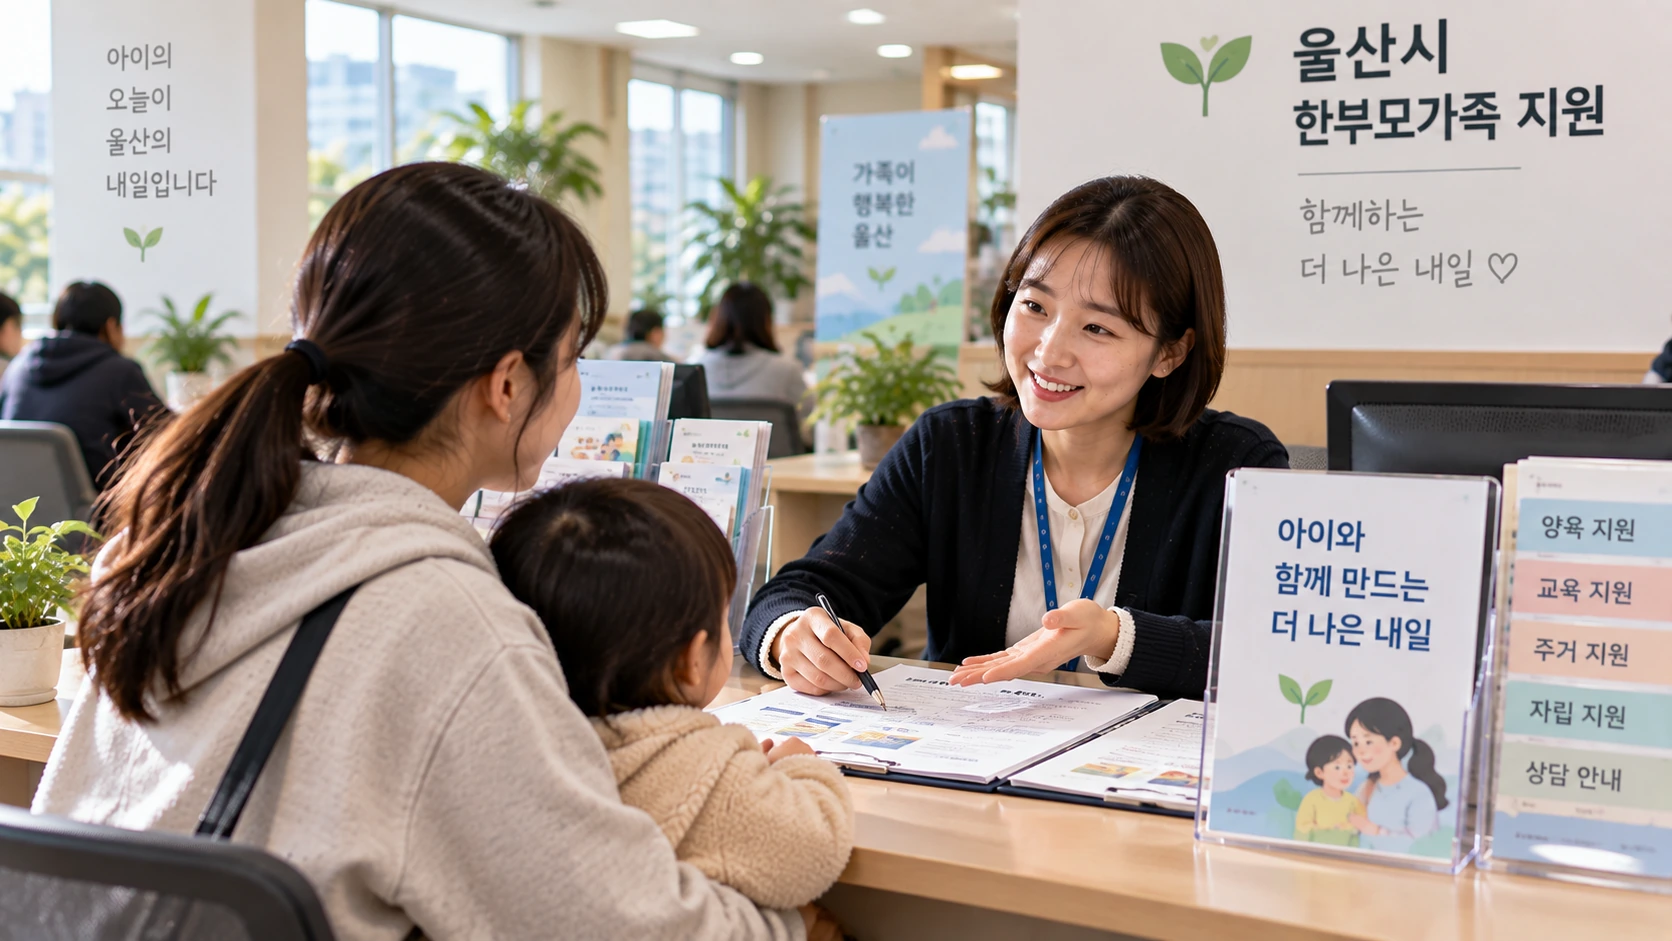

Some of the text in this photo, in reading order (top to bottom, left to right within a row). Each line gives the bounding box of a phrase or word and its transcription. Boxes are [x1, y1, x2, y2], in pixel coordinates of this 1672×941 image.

[107, 41, 172, 72] 아이의
[1293, 18, 1448, 84] 울산시
[106, 84, 171, 114] 오늘이
[1292, 84, 1604, 147] 한부모가족 지원
[105, 126, 171, 157] 울산의
[106, 169, 218, 199] 내일입니다
[853, 159, 915, 185] 가족이
[853, 191, 915, 217] 행복한
[1299, 197, 1424, 235] 함께하는
[853, 223, 893, 249] 울산
[1300, 249, 1473, 289] 더 나은 내일
[1278, 517, 1366, 553] 아이와
[1541, 515, 1635, 543] 양육 지원
[1275, 561, 1429, 603] 함께 만드는
[1537, 578, 1632, 606] 교육 지원
[1271, 609, 1431, 652] 더 나은 내일
[1533, 637, 1629, 668] 주거 지원
[1529, 699, 1626, 730] 자립 지원
[1525, 761, 1622, 793] 상담 안내
